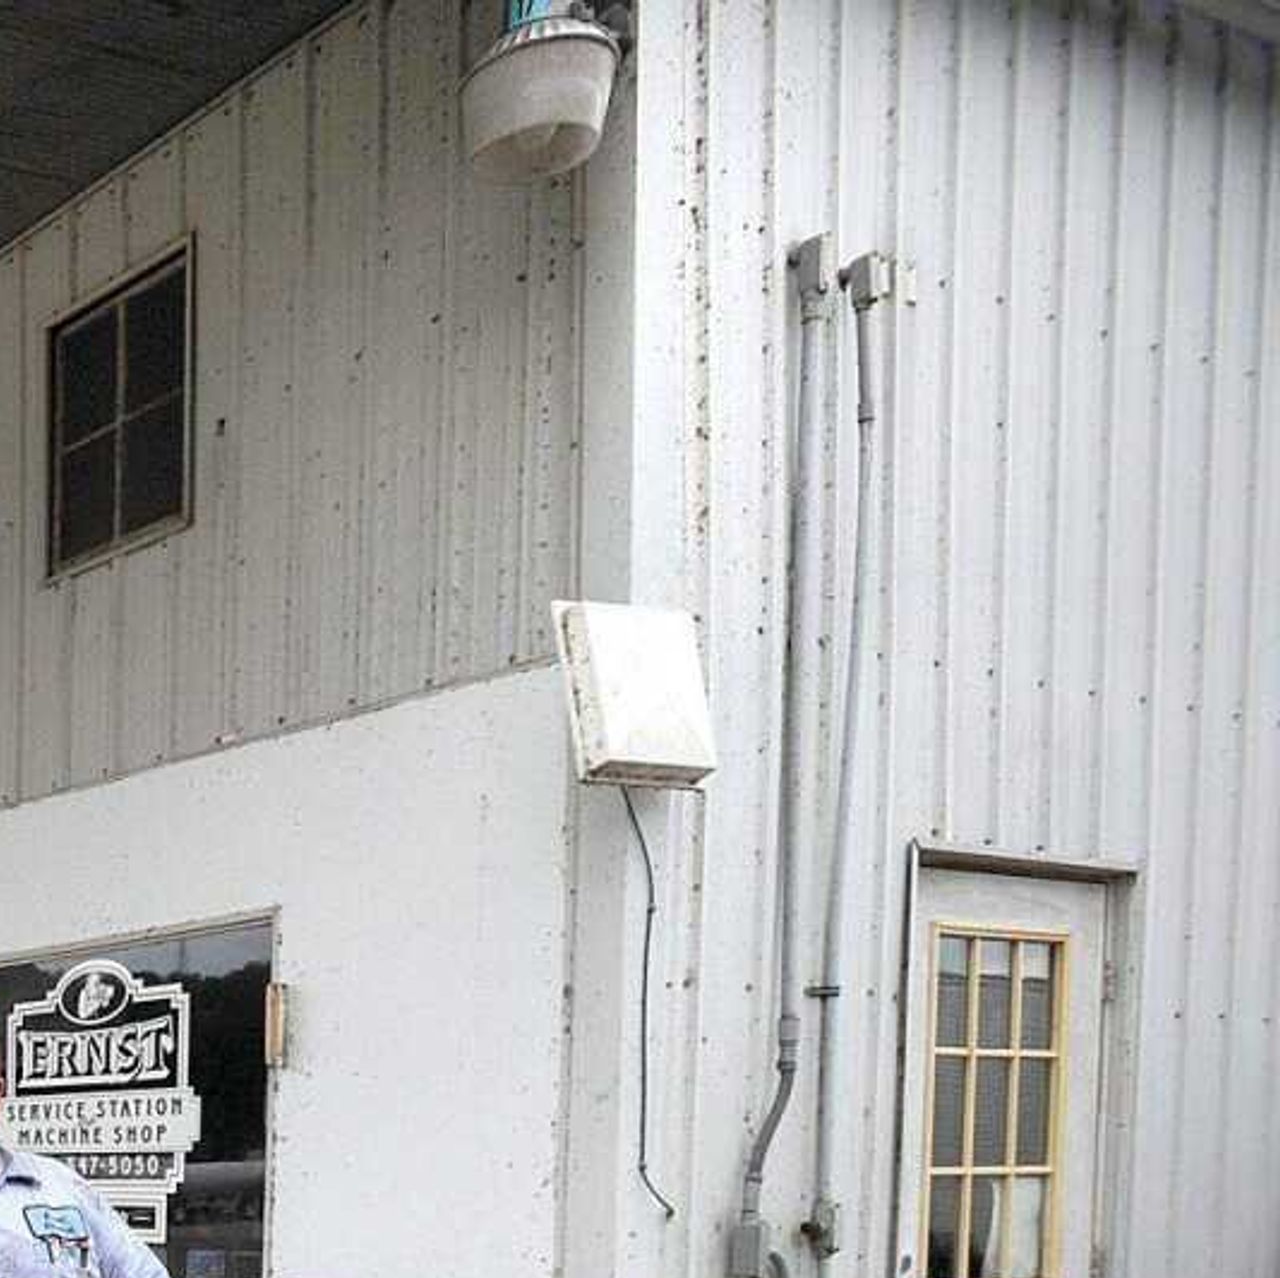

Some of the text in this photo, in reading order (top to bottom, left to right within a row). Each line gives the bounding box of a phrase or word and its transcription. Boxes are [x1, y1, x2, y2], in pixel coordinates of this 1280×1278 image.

[23, 1019, 172, 1083] ERNST
[7, 1101, 86, 1122] SERVICE
[96, 1097, 182, 1118] STATION
[18, 1124, 167, 1146] MACHINE SHOP
